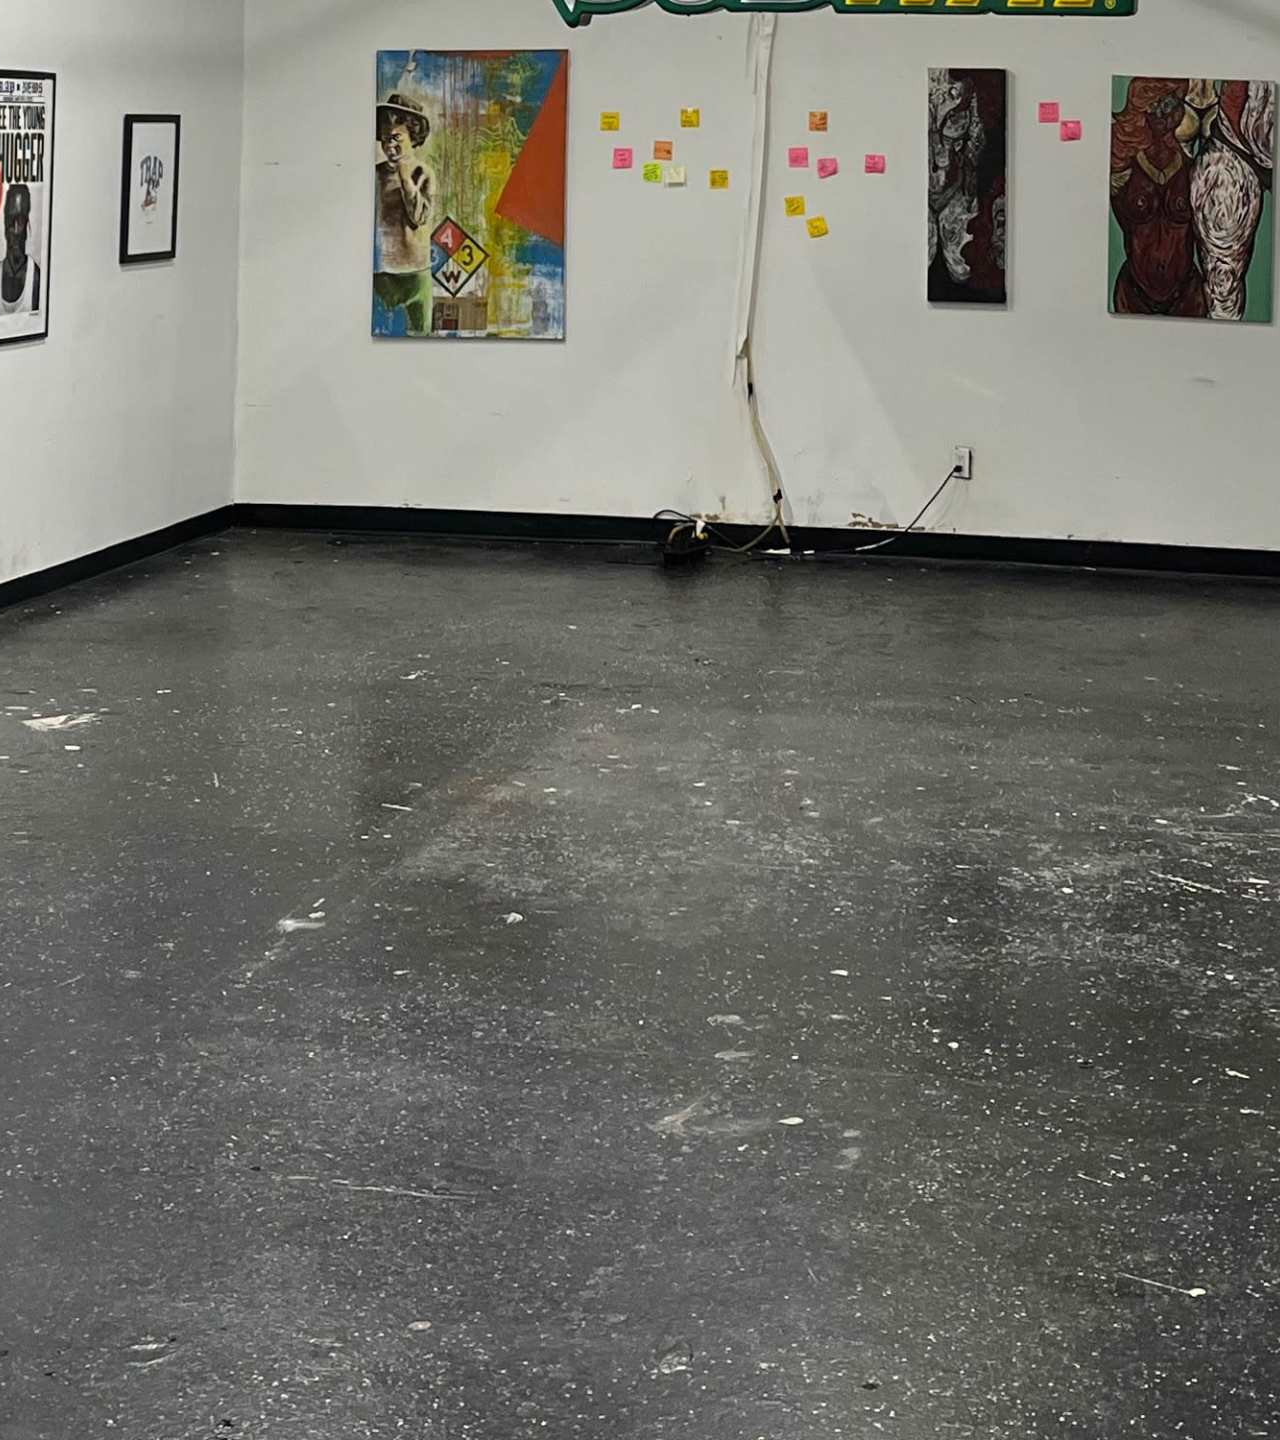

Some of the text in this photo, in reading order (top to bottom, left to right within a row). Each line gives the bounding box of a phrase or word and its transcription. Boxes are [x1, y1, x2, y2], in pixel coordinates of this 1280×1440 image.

[8, 105, 22, 130] THE
[23, 105, 46, 130] YOUNG
[140, 154, 164, 187] TRAP
[461, 244, 474, 266] 3
[442, 270, 461, 284] W
